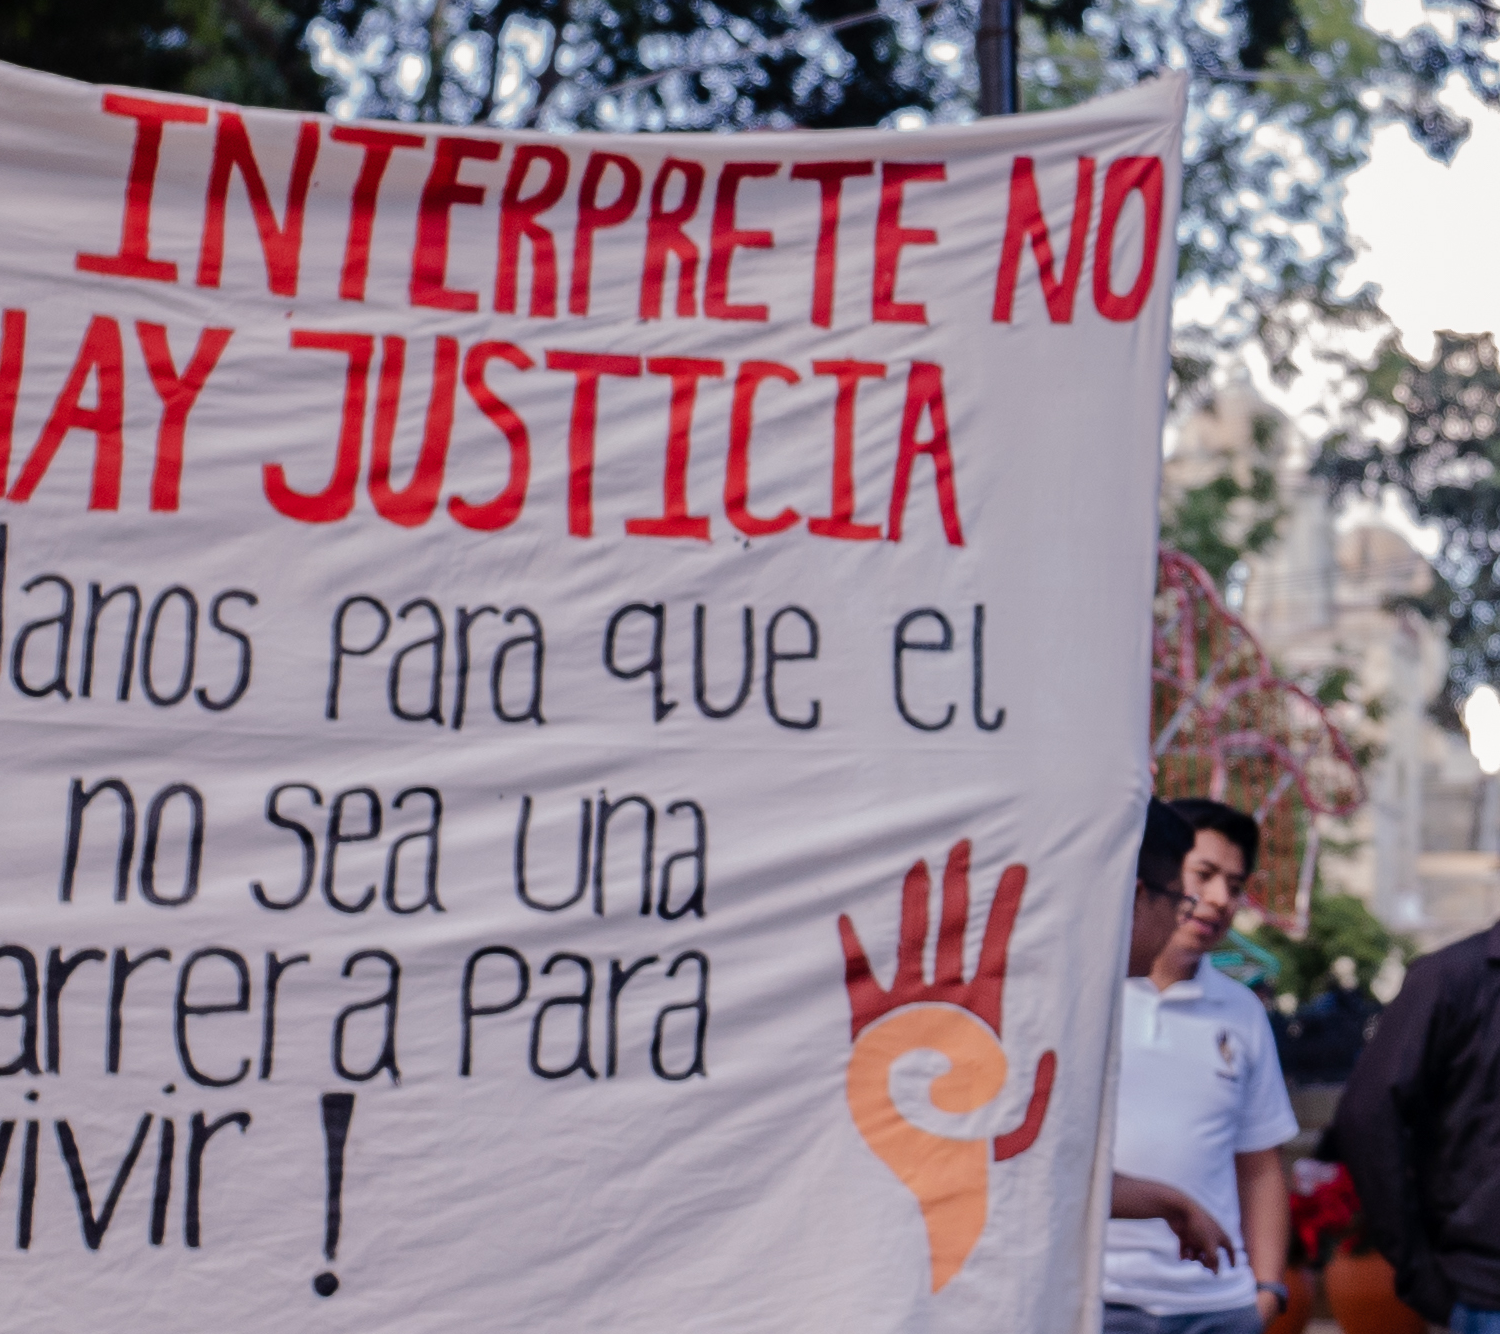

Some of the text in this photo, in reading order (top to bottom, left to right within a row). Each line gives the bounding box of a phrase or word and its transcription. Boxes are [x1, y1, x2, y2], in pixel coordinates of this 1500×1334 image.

[76, 93, 945, 328] INTERPRETE
[993, 155, 1164, 325] NO
[263, 329, 964, 546] JUSTICIA
[603, 599, 820, 731] que
[893, 603, 1007, 732] el
[62, 779, 204, 907] no
[253, 783, 446, 915] sea
[515, 791, 706, 921] una
